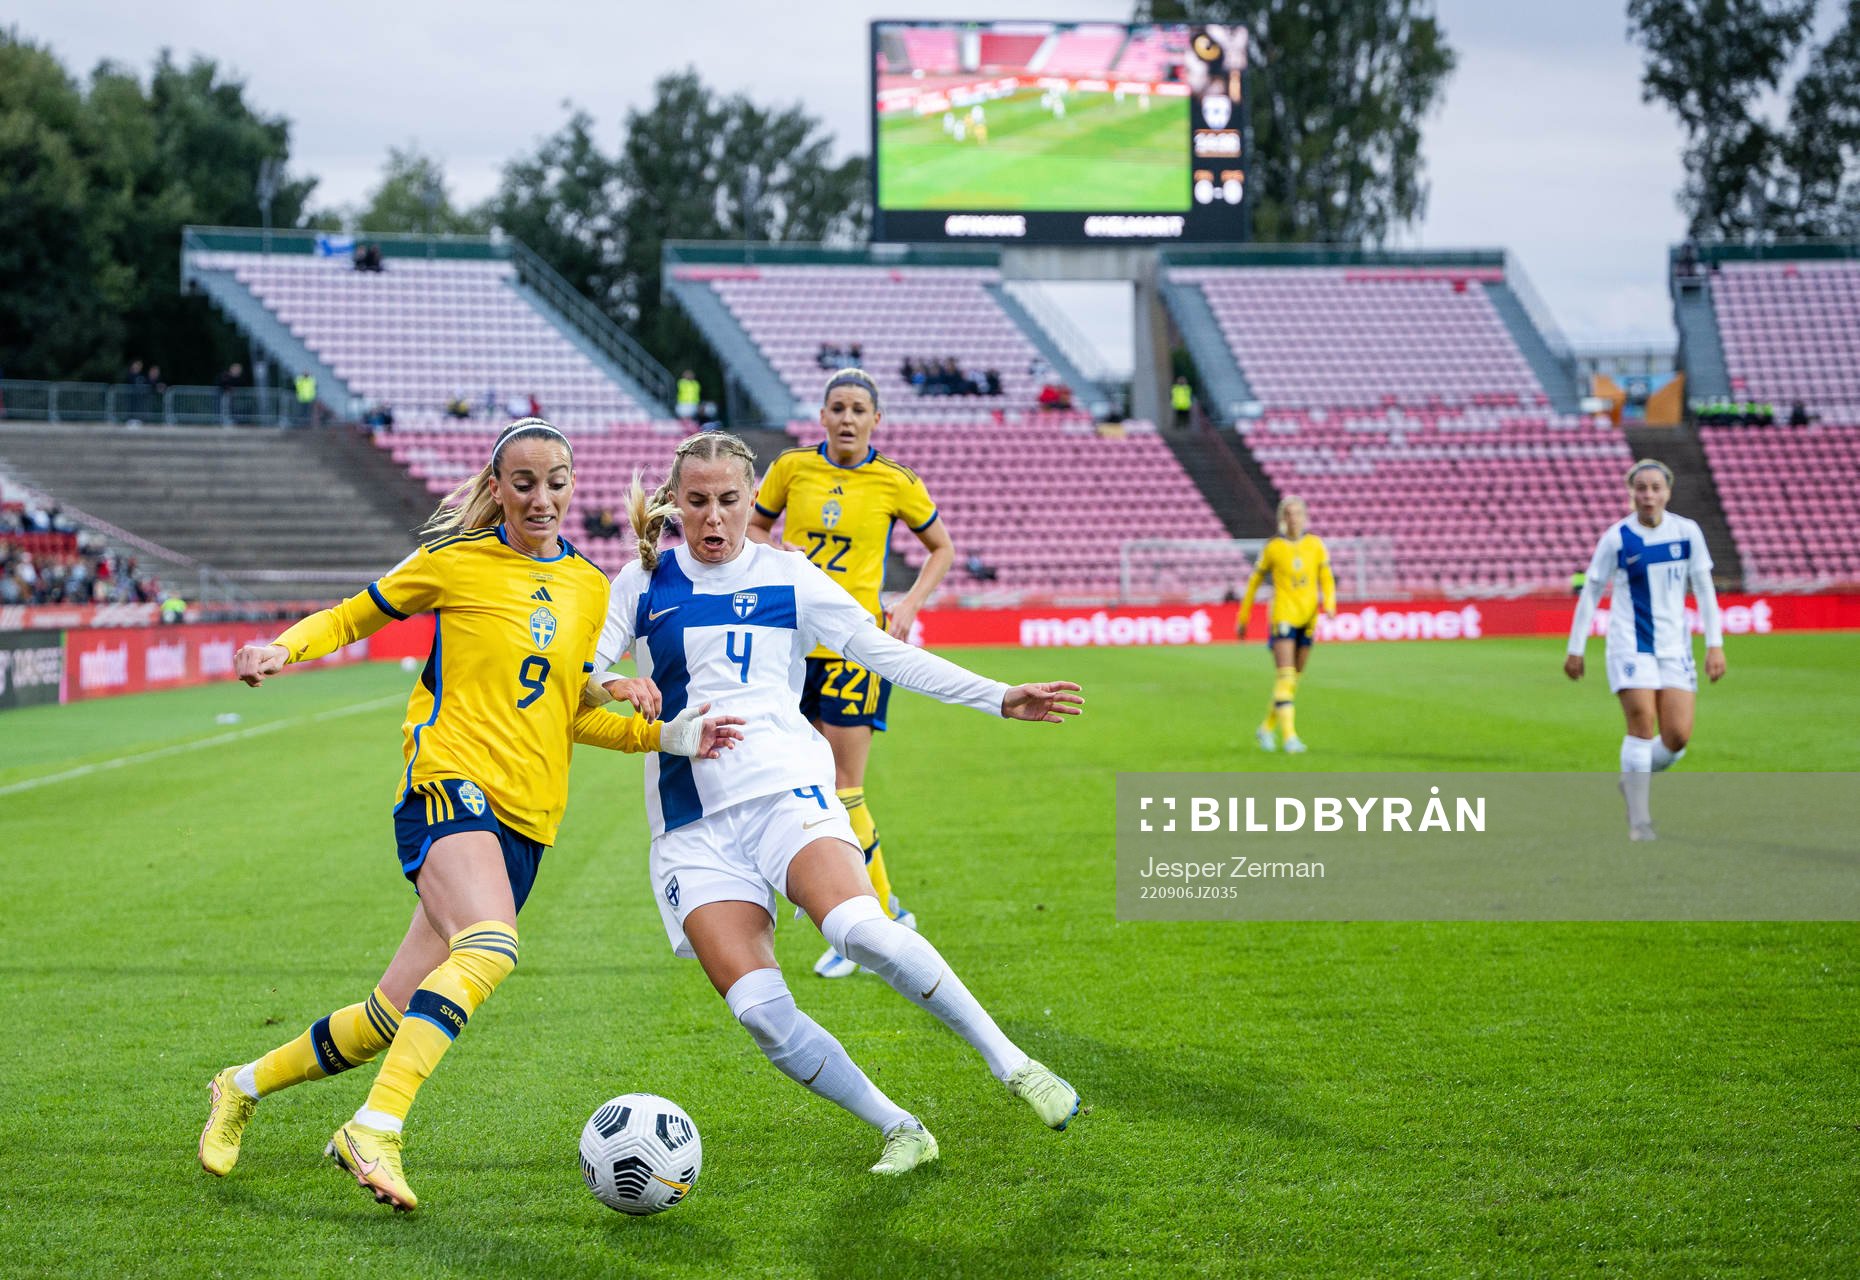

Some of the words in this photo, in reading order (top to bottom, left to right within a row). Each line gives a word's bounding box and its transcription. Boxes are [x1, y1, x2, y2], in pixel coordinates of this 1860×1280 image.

[806, 531, 852, 572] 22
[1020, 609, 1212, 647] motonet
[726, 631, 753, 683] 4
[516, 654, 551, 709] 9
[820, 660, 867, 701] 22
[792, 785, 829, 810] 4
